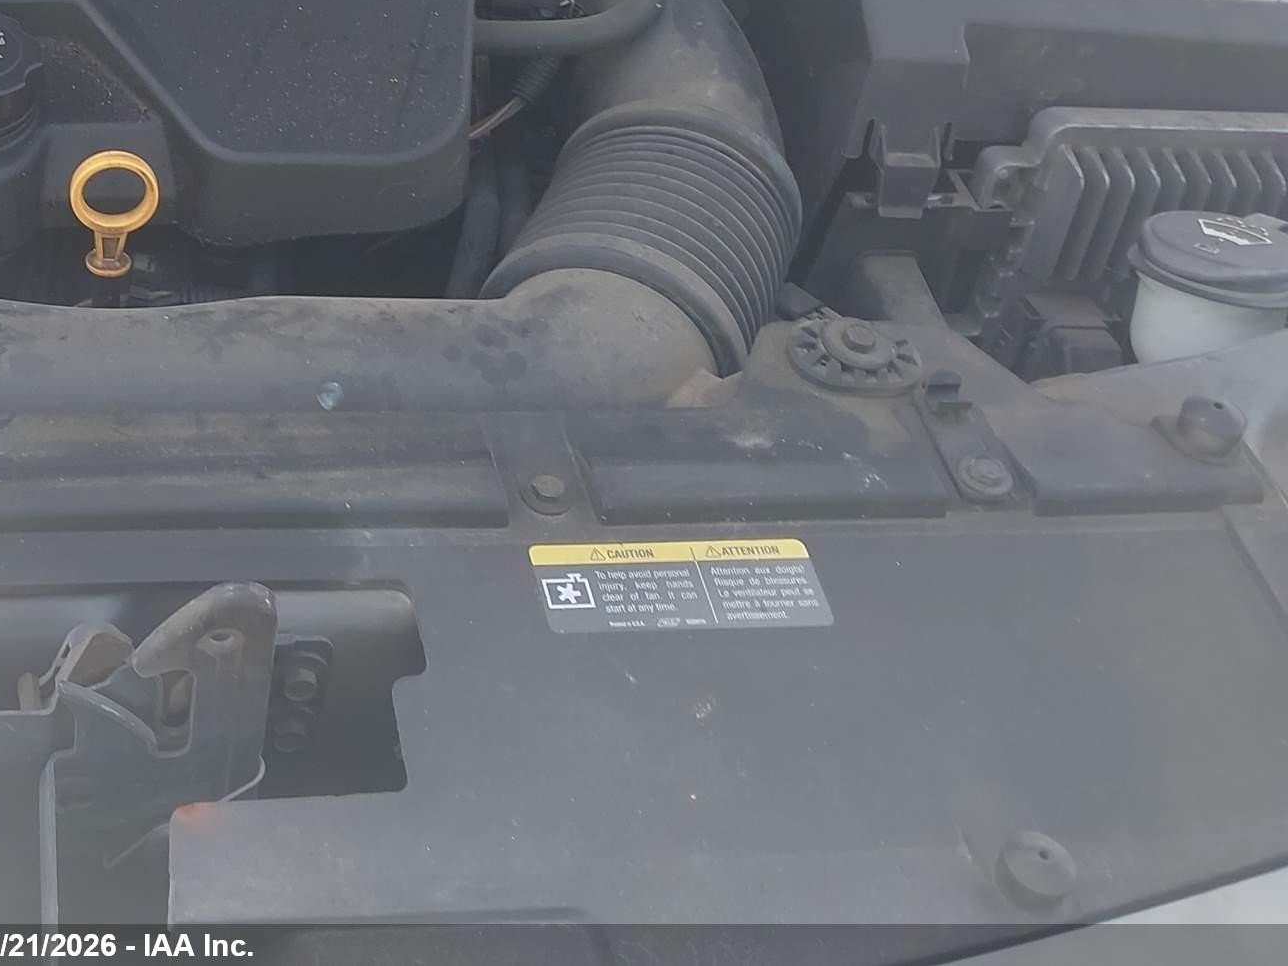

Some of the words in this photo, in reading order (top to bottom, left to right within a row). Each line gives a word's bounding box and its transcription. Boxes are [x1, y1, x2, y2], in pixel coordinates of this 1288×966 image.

[608, 549, 654, 559] CAUTION
[722, 546, 780, 555] ATTENTION
[595, 571, 606, 579] To
[608, 570, 626, 580] help
[628, 570, 651, 578] avoid
[653, 570, 690, 578] personal
[711, 567, 750, 575] Attention
[634, 581, 657, 590] keep
[666, 580, 694, 588] hands
[714, 578, 744, 586] Risque
[602, 593, 623, 601] clear
[631, 592, 639, 600] of
[645, 592, 662, 600] fan.
[668, 591, 675, 599] It
[718, 589, 729, 597] Le
[733, 588, 777, 596] ventilateur
[781, 588, 800, 596] peut
[605, 605, 625, 613] start
[628, 604, 637, 612] at
[639, 604, 653, 613] any
[723, 600, 751, 609] mettre
[727, 611, 790, 620] avertissement.
